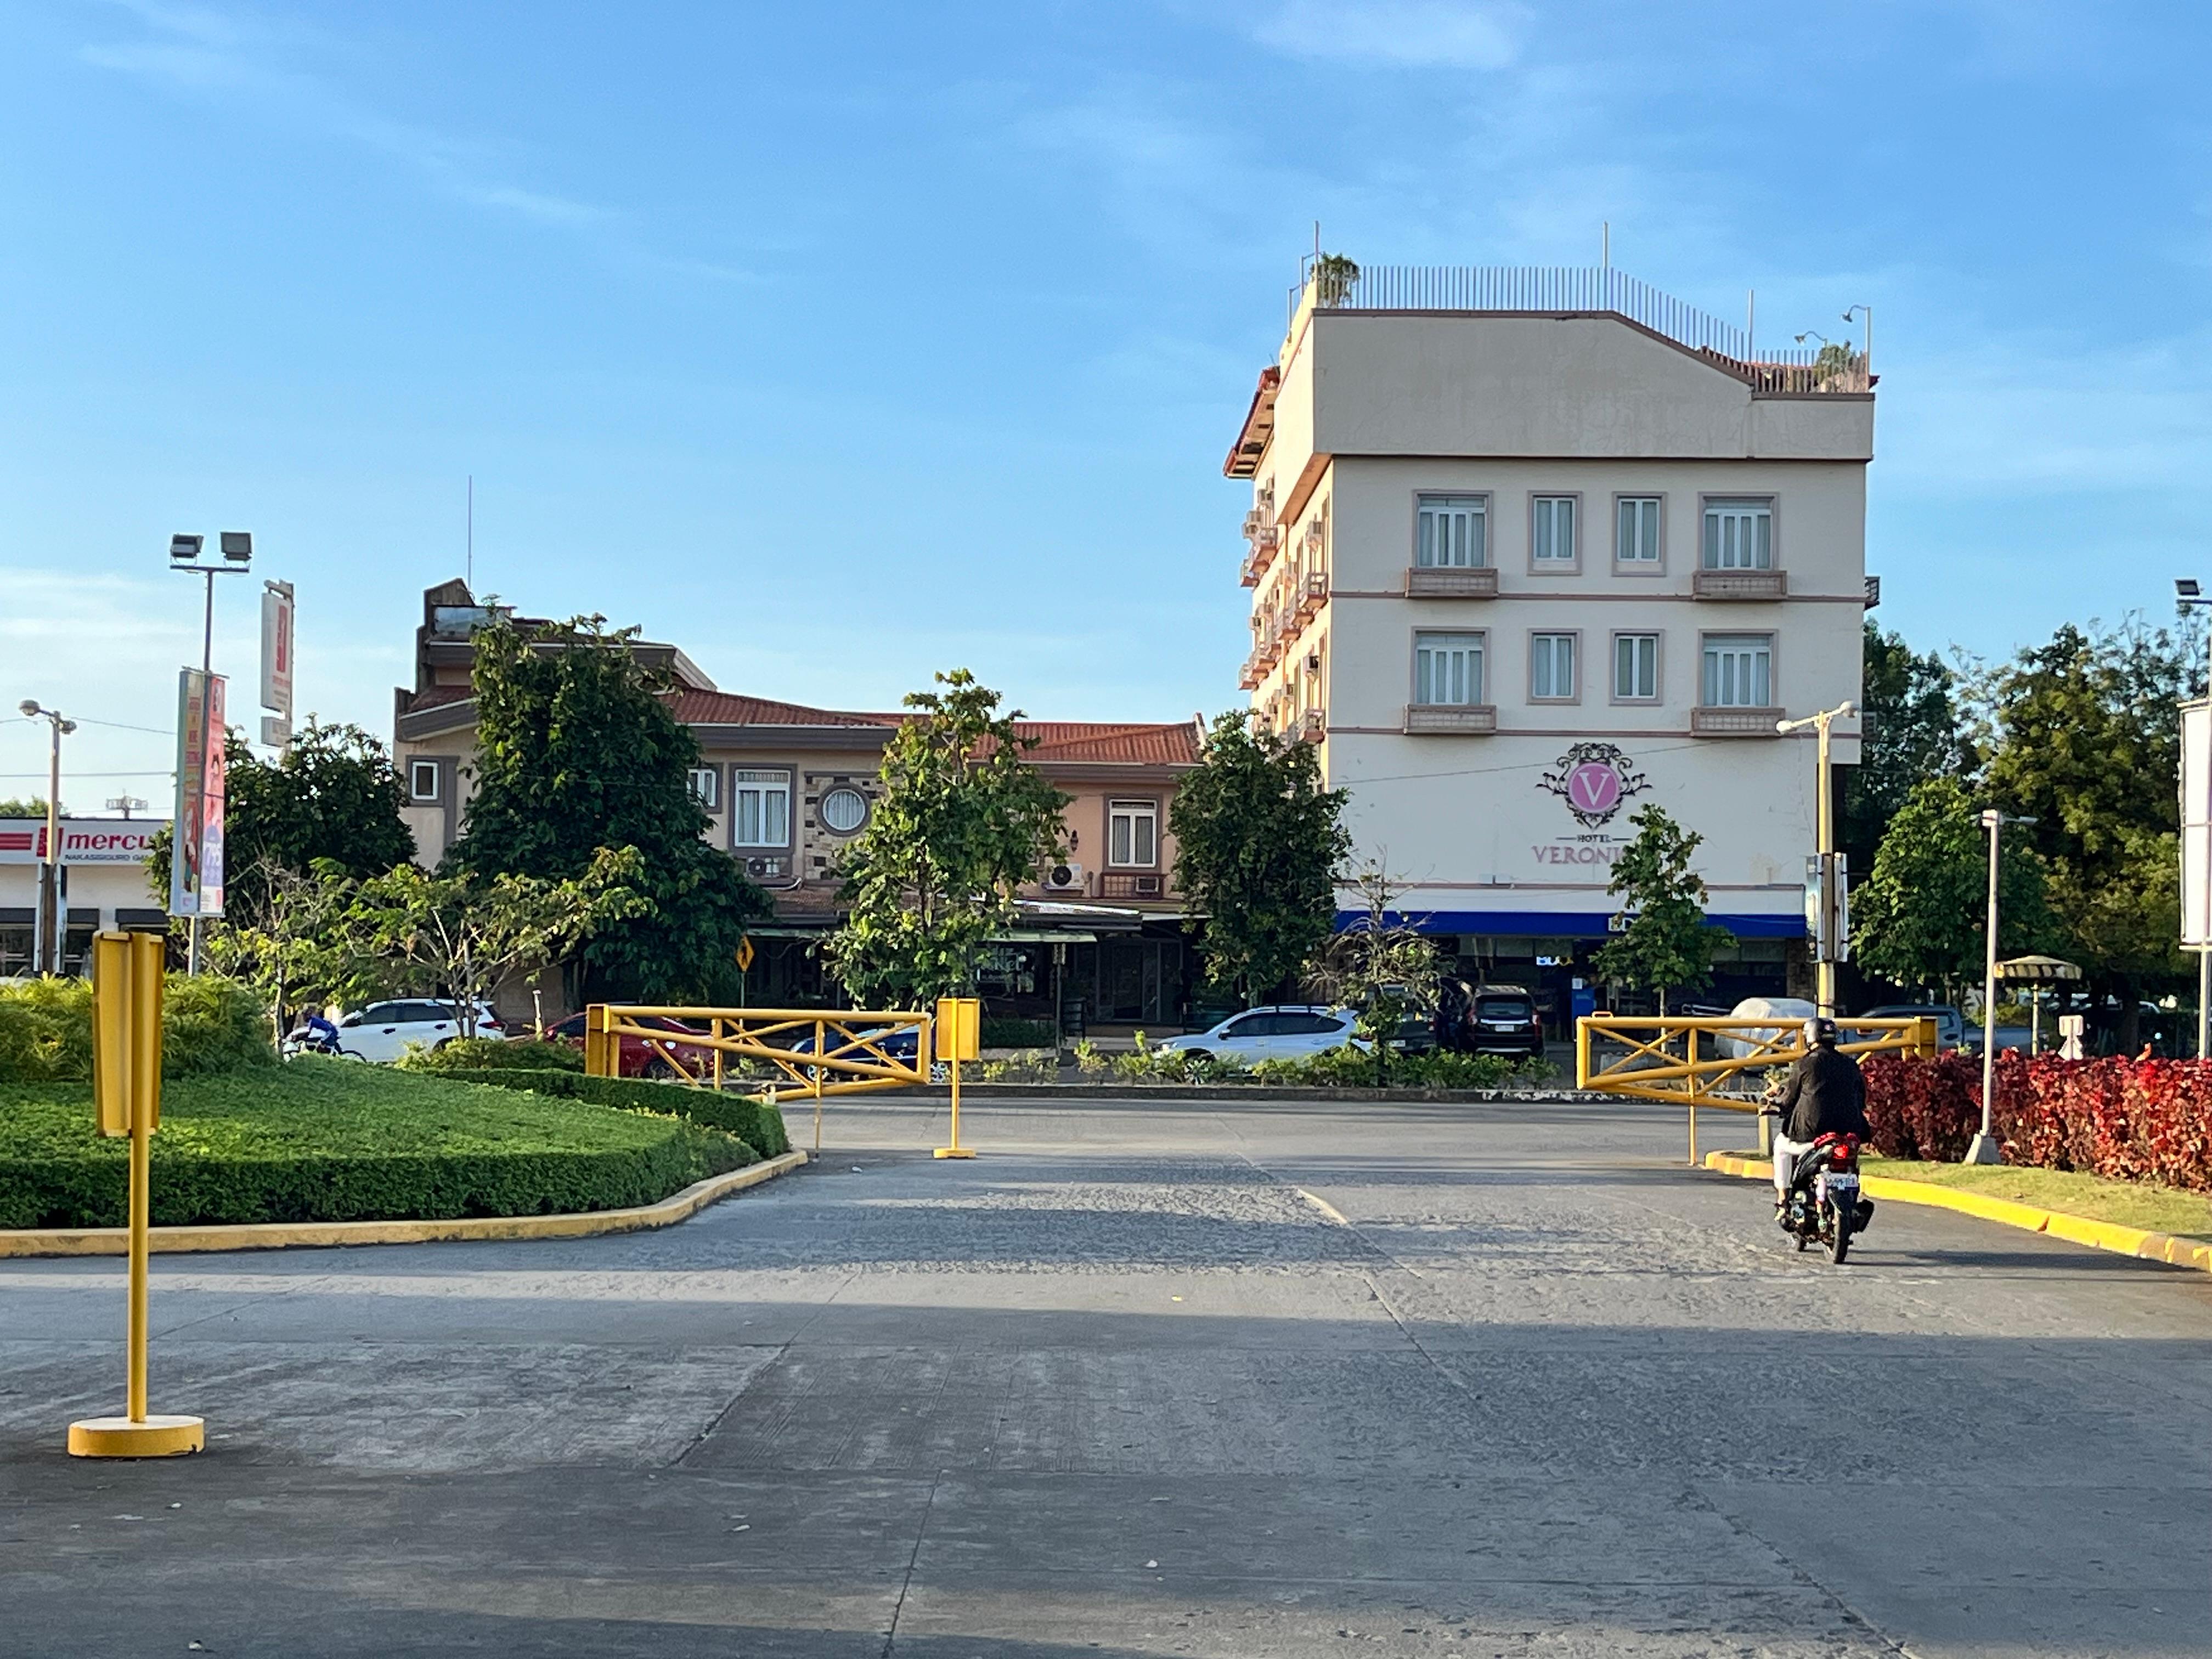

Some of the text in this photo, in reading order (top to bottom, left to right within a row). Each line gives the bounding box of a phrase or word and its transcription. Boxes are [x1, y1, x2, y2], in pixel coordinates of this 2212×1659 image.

[1578, 772, 1611, 807] V
[1577, 834, 1612, 843] HOTEL
[1532, 845, 1623, 864] VERONI
